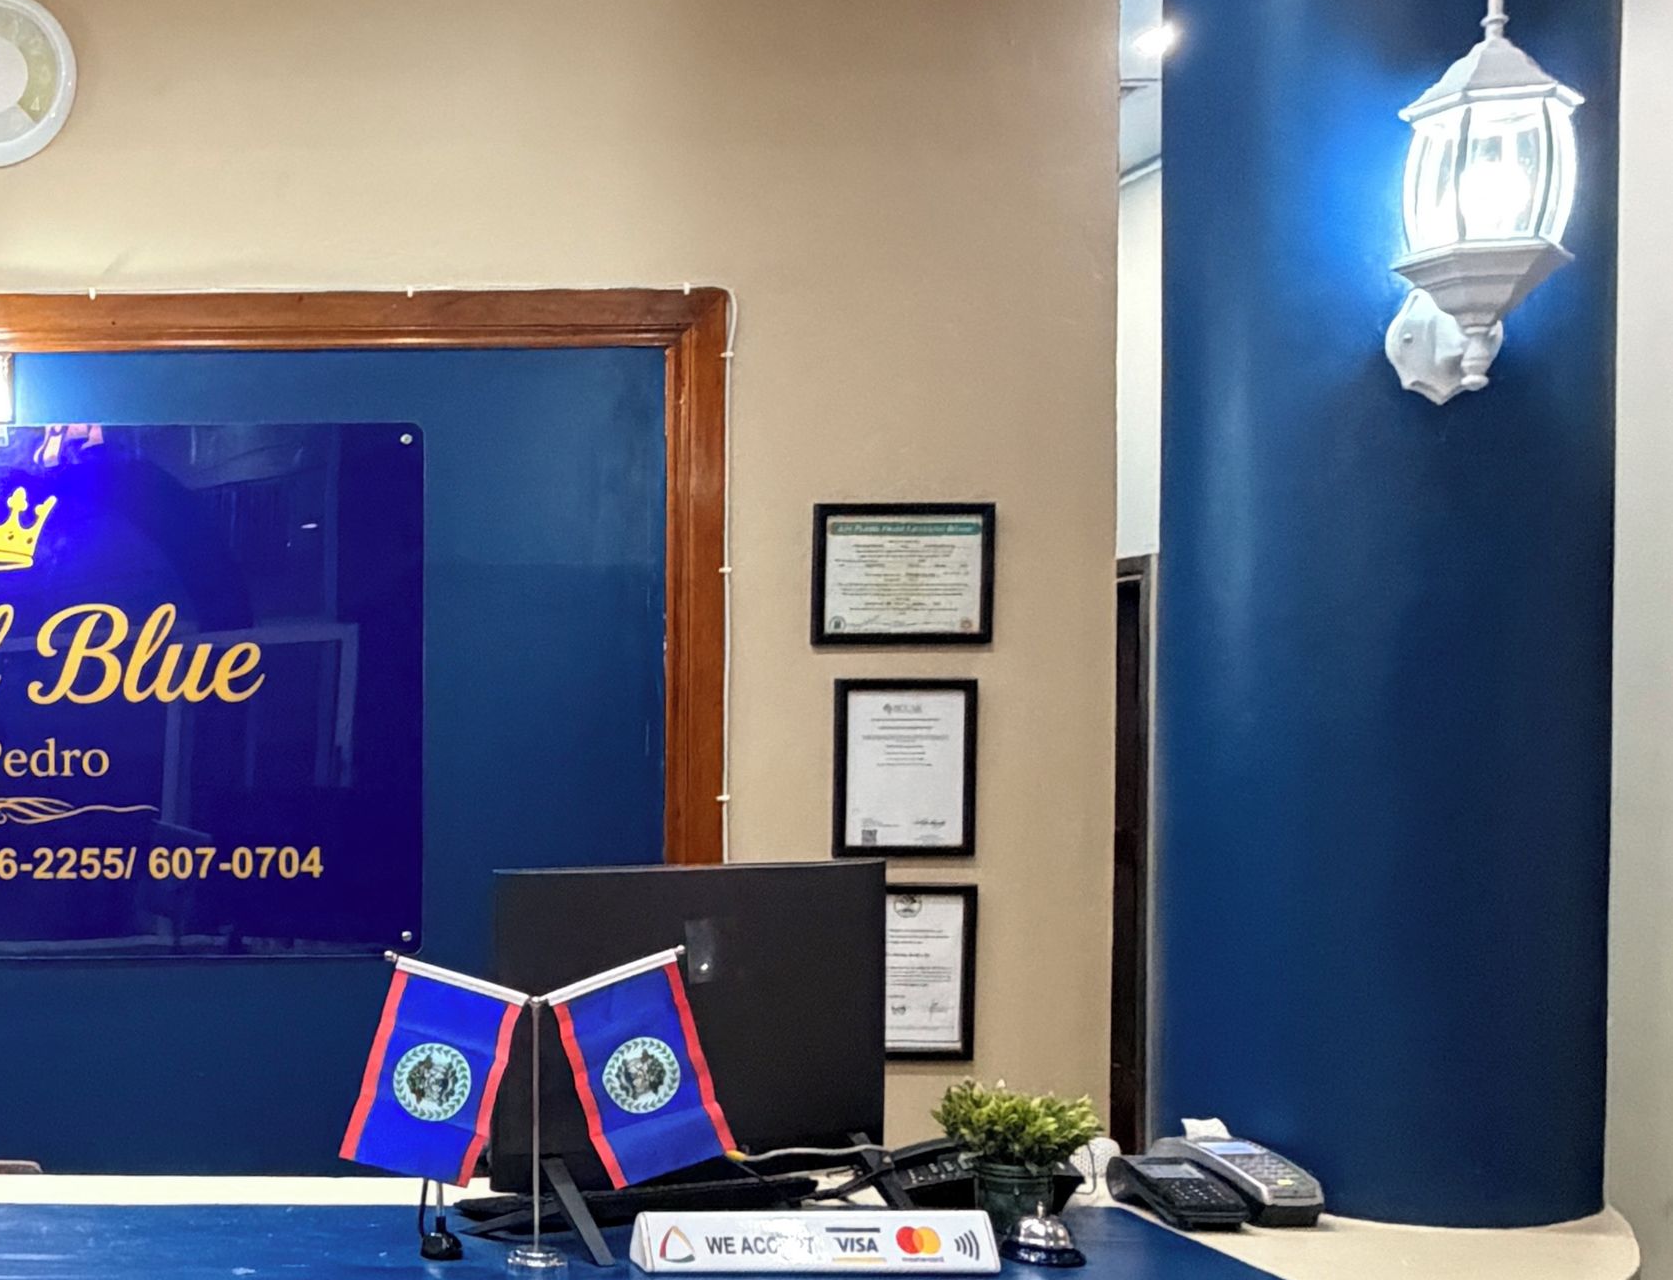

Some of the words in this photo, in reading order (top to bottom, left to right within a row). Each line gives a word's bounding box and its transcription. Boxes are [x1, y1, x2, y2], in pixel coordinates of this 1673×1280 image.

[27, 602, 265, 705] Blue
[148, 846, 324, 880] 607-0704
[704, 1234, 738, 1256] WE
[740, 1234, 815, 1256] ACCT
[834, 1237, 880, 1253] VISA
